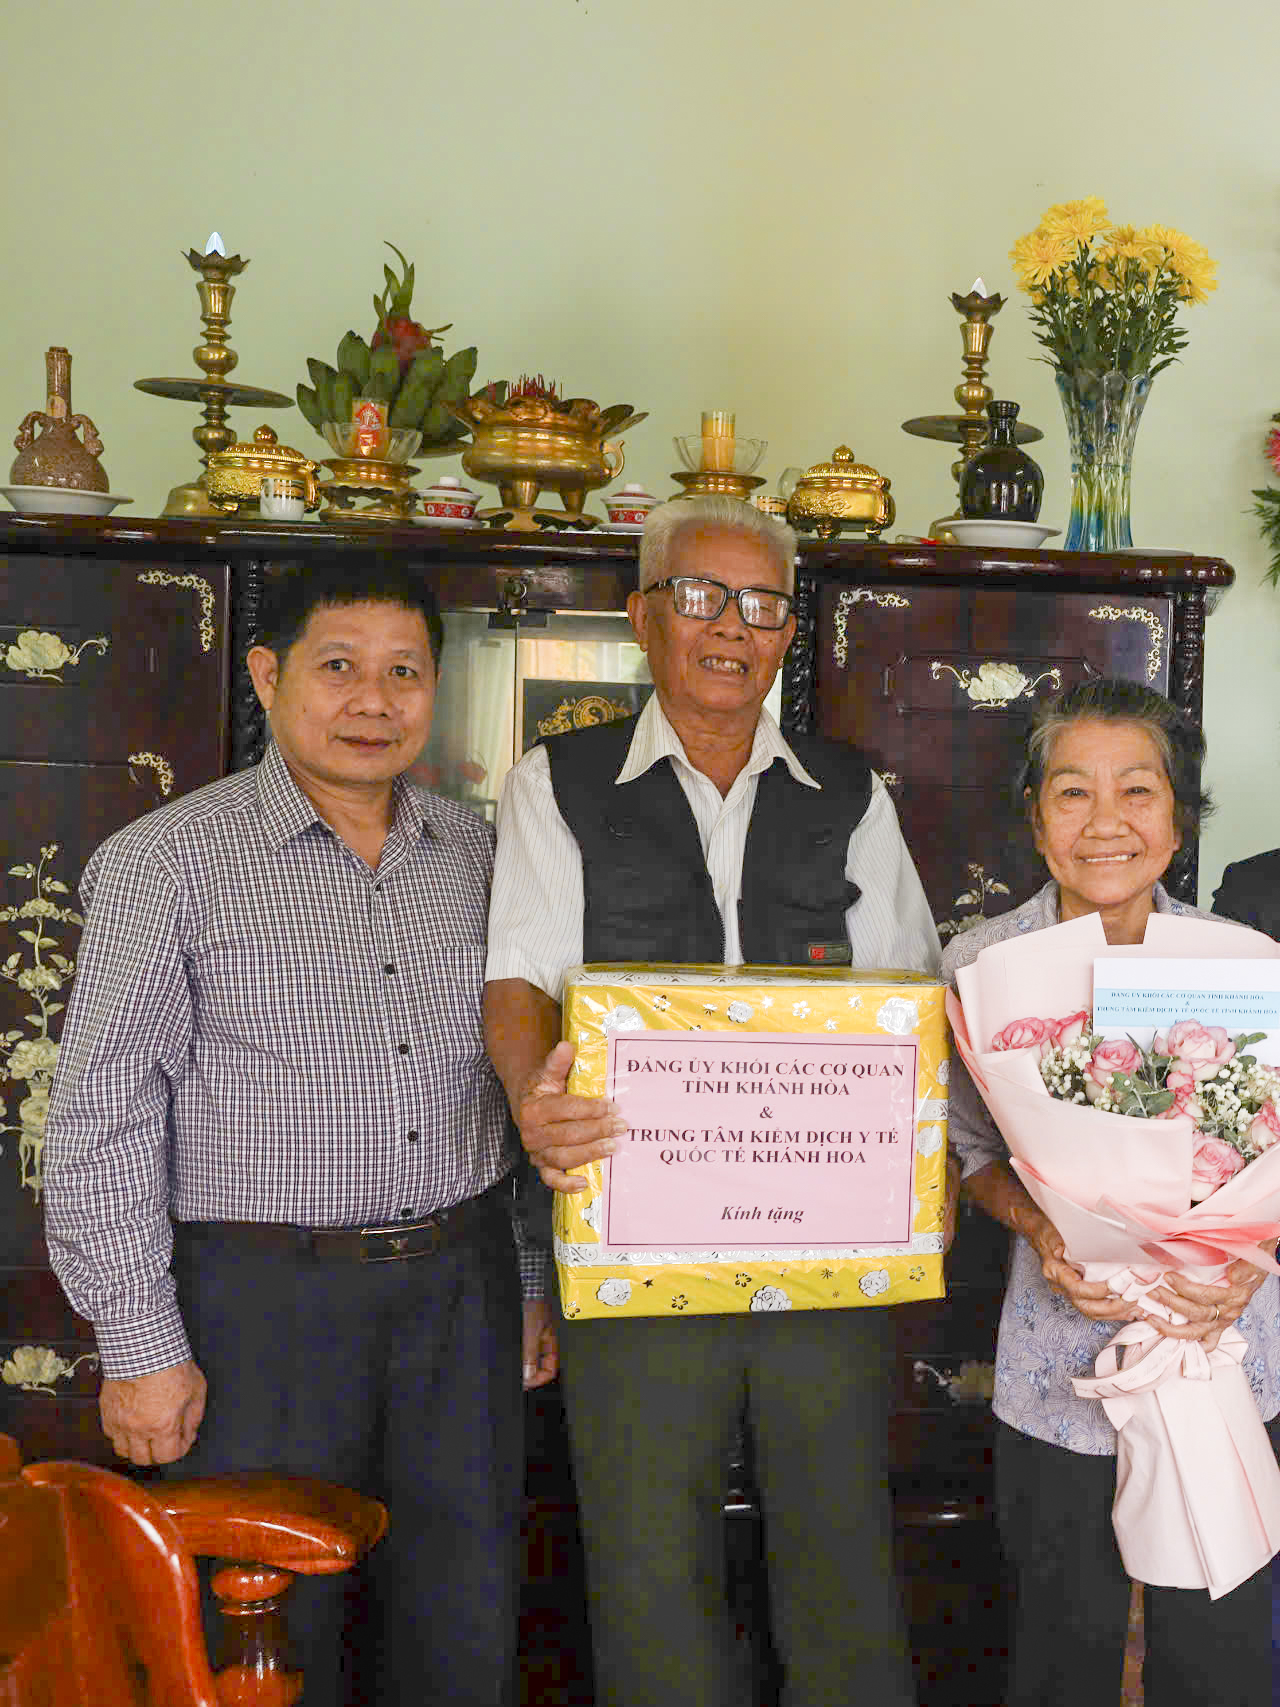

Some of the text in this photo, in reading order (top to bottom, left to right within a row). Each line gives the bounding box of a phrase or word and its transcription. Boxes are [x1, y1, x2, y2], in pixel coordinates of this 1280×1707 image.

[626, 1056, 682, 1073] ĐẢNG
[689, 1056, 715, 1073] ỦY
[775, 1059, 815, 1075] CÁC
[820, 1062, 848, 1076] CƠ
[852, 1063, 904, 1079] QUAN
[682, 1076, 850, 1095] TỈNH KHÁNH HÒA
[759, 1106, 774, 1119] &
[626, 1128, 696, 1142] TRUNG
[701, 1126, 744, 1142] TÂM
[806, 1131, 852, 1147] DỊCH
[859, 1131, 870, 1144] Y
[752, 1147, 820, 1163] KHÁNH
[721, 1206, 804, 1224] Kính tặng
